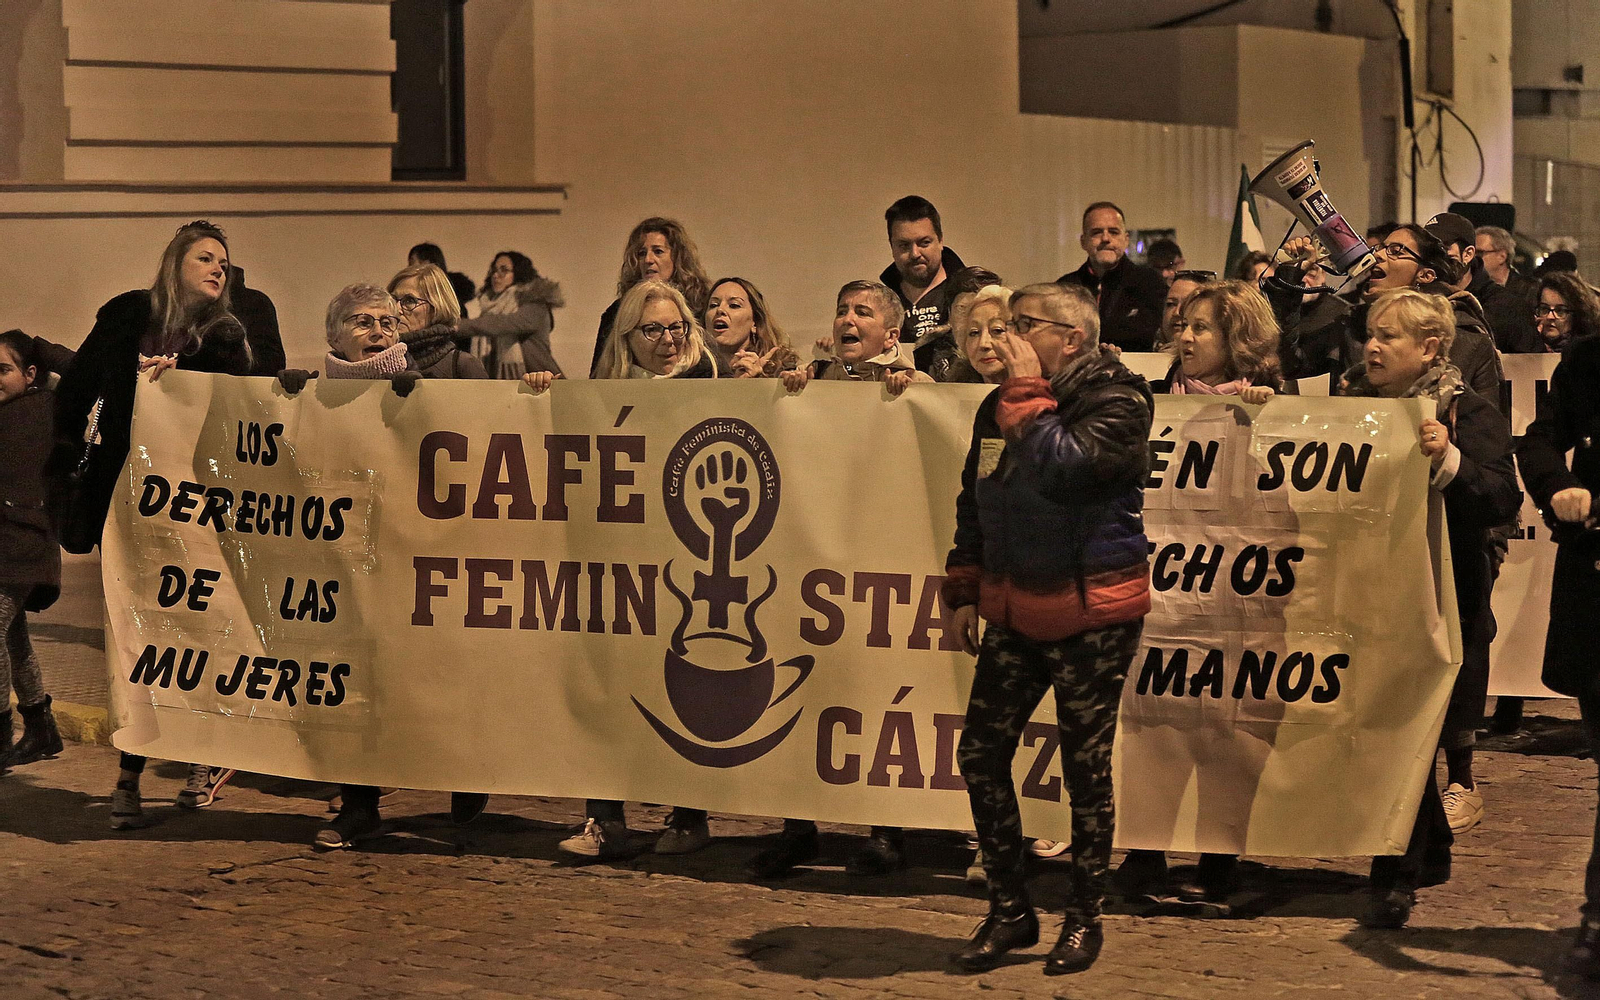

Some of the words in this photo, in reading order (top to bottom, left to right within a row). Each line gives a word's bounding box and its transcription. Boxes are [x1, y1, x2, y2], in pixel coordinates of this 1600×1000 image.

[235, 420, 284, 467] LOS
[417, 405, 646, 524] CAFÉ
[681, 421, 746, 457] Feminista
[747, 434, 760, 451] de
[1257, 440, 1373, 493] SON
[138, 474, 353, 542] DERECHOS
[156, 565, 221, 612] DE
[278, 576, 340, 623] LAS
